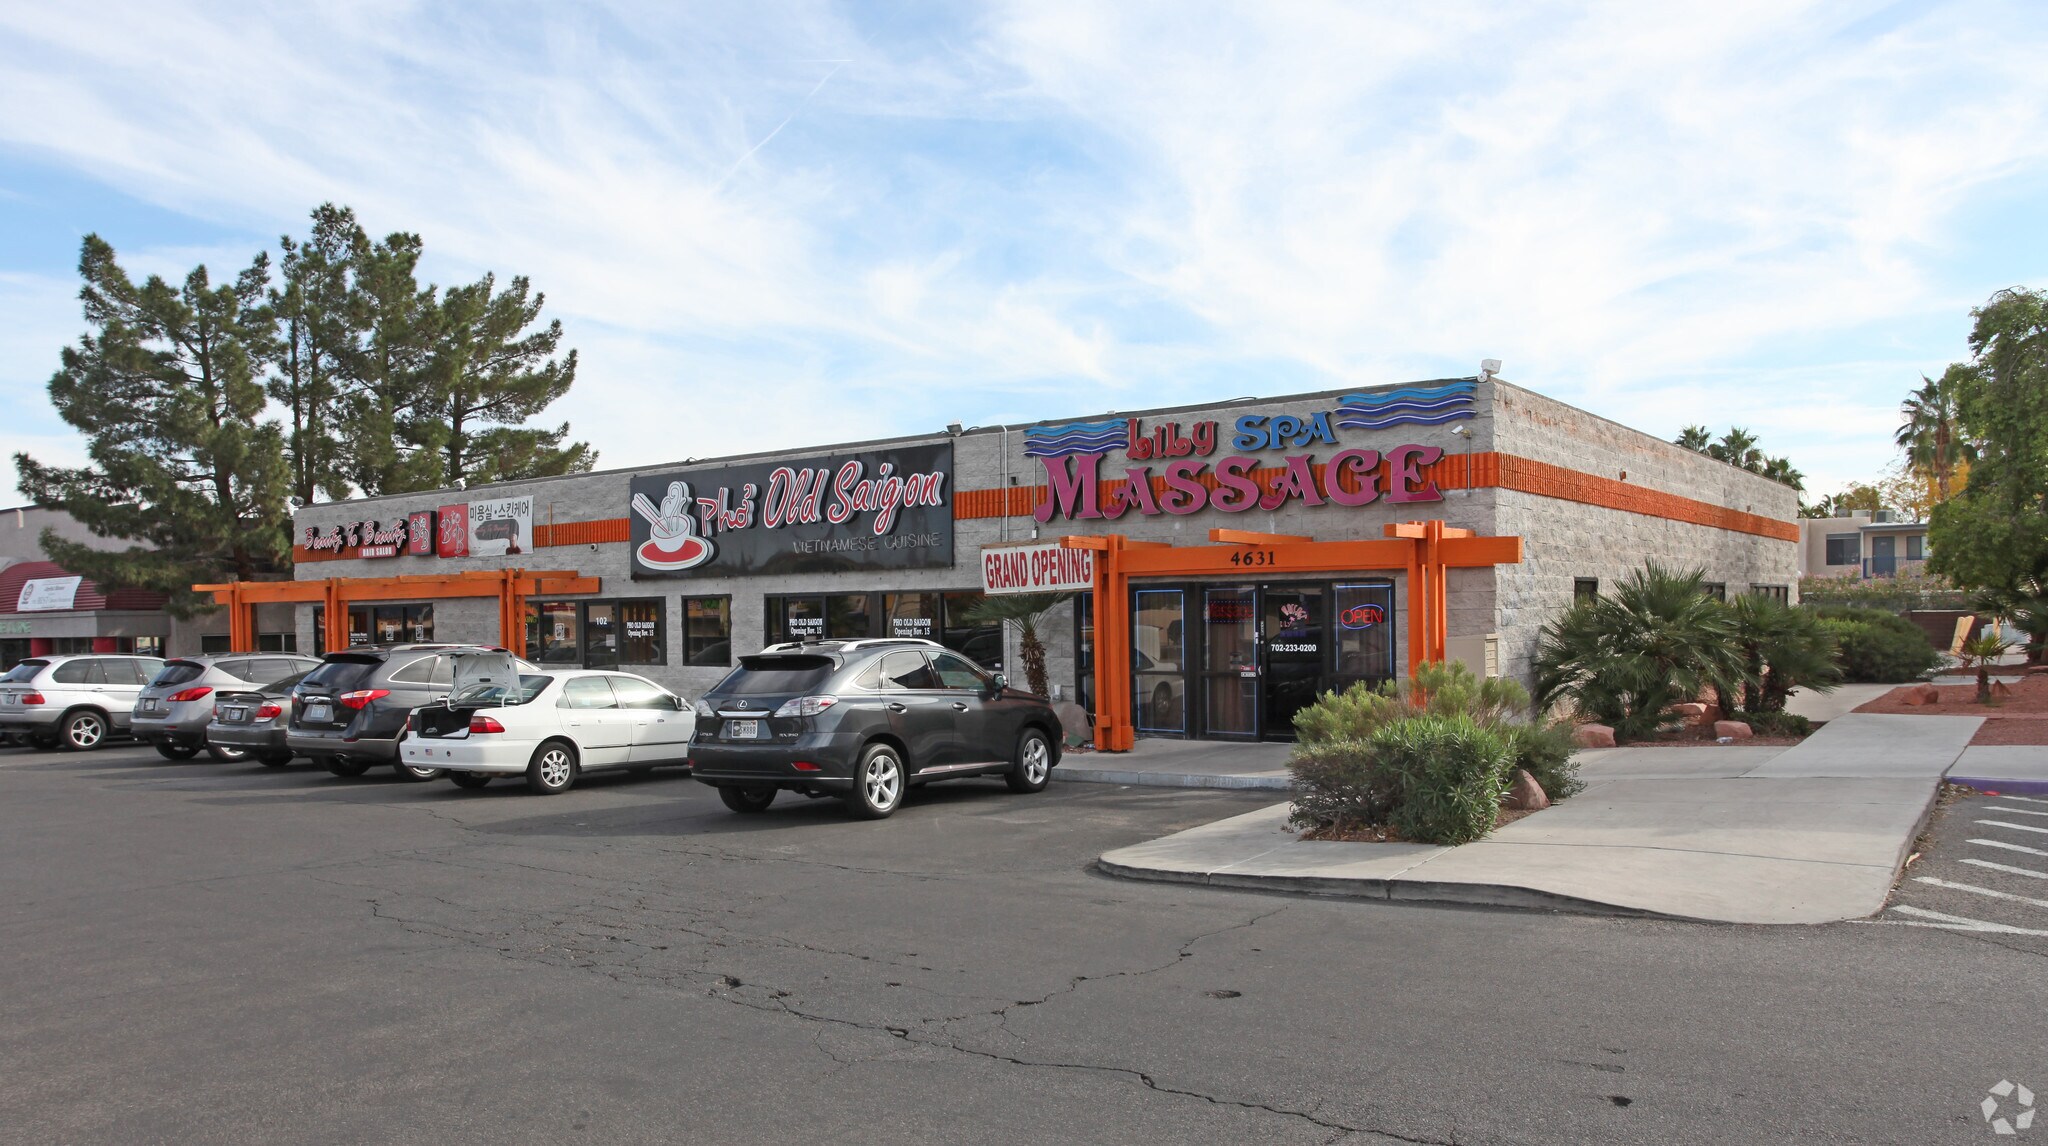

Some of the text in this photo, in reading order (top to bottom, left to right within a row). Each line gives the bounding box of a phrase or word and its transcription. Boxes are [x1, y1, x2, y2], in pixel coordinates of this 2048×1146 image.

[1232, 410, 1339, 452] SPA
[1033, 444, 1446, 523] MASSAGE
[763, 467, 829, 528] Old
[827, 460, 945, 535] Saigon
[304, 526, 343, 553] Beauty
[363, 520, 407, 548] Beauty
[793, 532, 942, 554] VIETNAMESE CUISINE
[1230, 551, 1276, 566] 4631
[985, 548, 1091, 589] GRAND OPENING
[595, 616, 608, 625] 102
[893, 618, 931, 627] PHO OLD SAIGON
[1340, 609, 1383, 625] OPEN
[790, 627, 807, 636] Opening
[807, 627, 816, 635] Nov.
[894, 627, 930, 637] Opening Nov. 15
[1271, 644, 1317, 652] 702-233-0200
